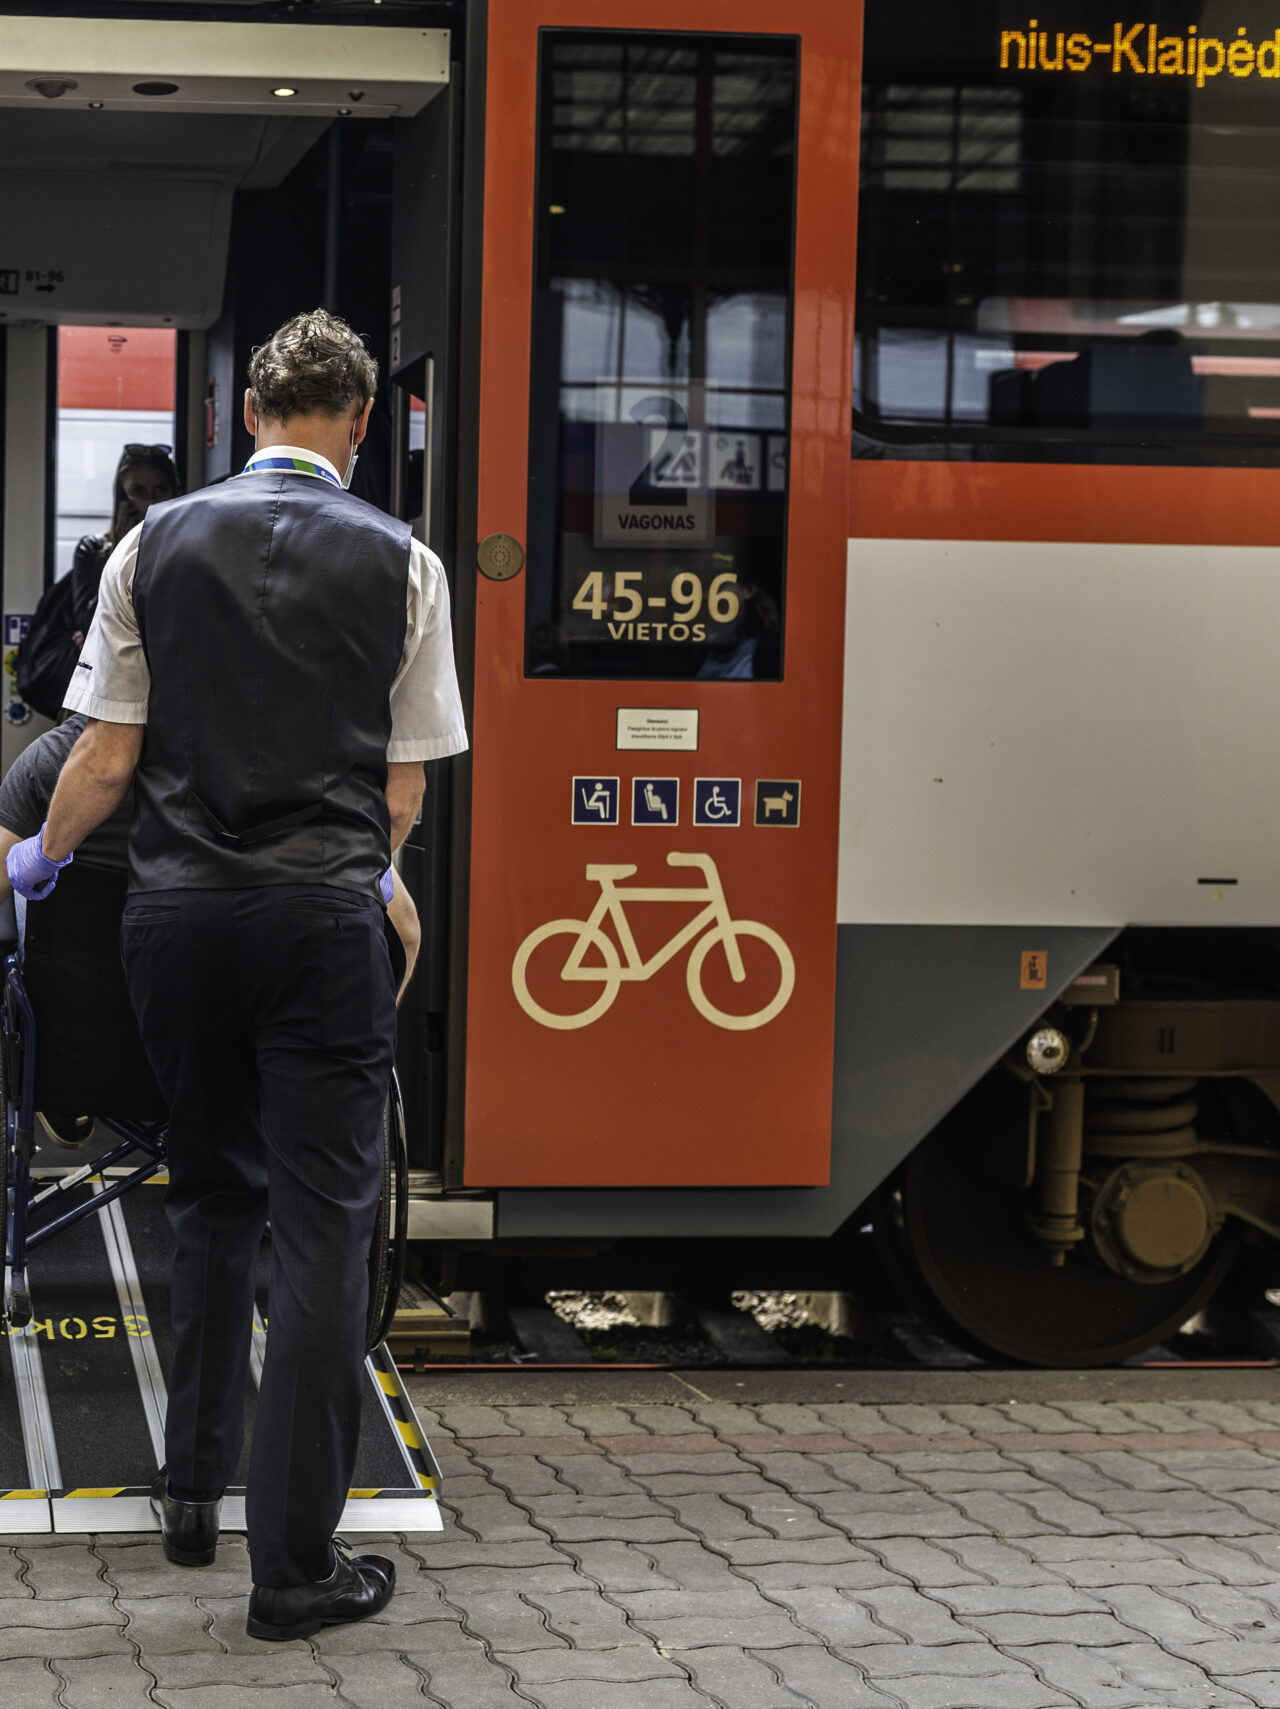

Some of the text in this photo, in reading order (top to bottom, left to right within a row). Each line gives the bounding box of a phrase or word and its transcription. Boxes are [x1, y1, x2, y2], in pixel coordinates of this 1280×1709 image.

[25, 269, 65, 282] 81-96
[618, 514, 696, 531] VAGONAS
[572, 571, 740, 624] 45-96
[607, 622, 706, 642] VIETOS
